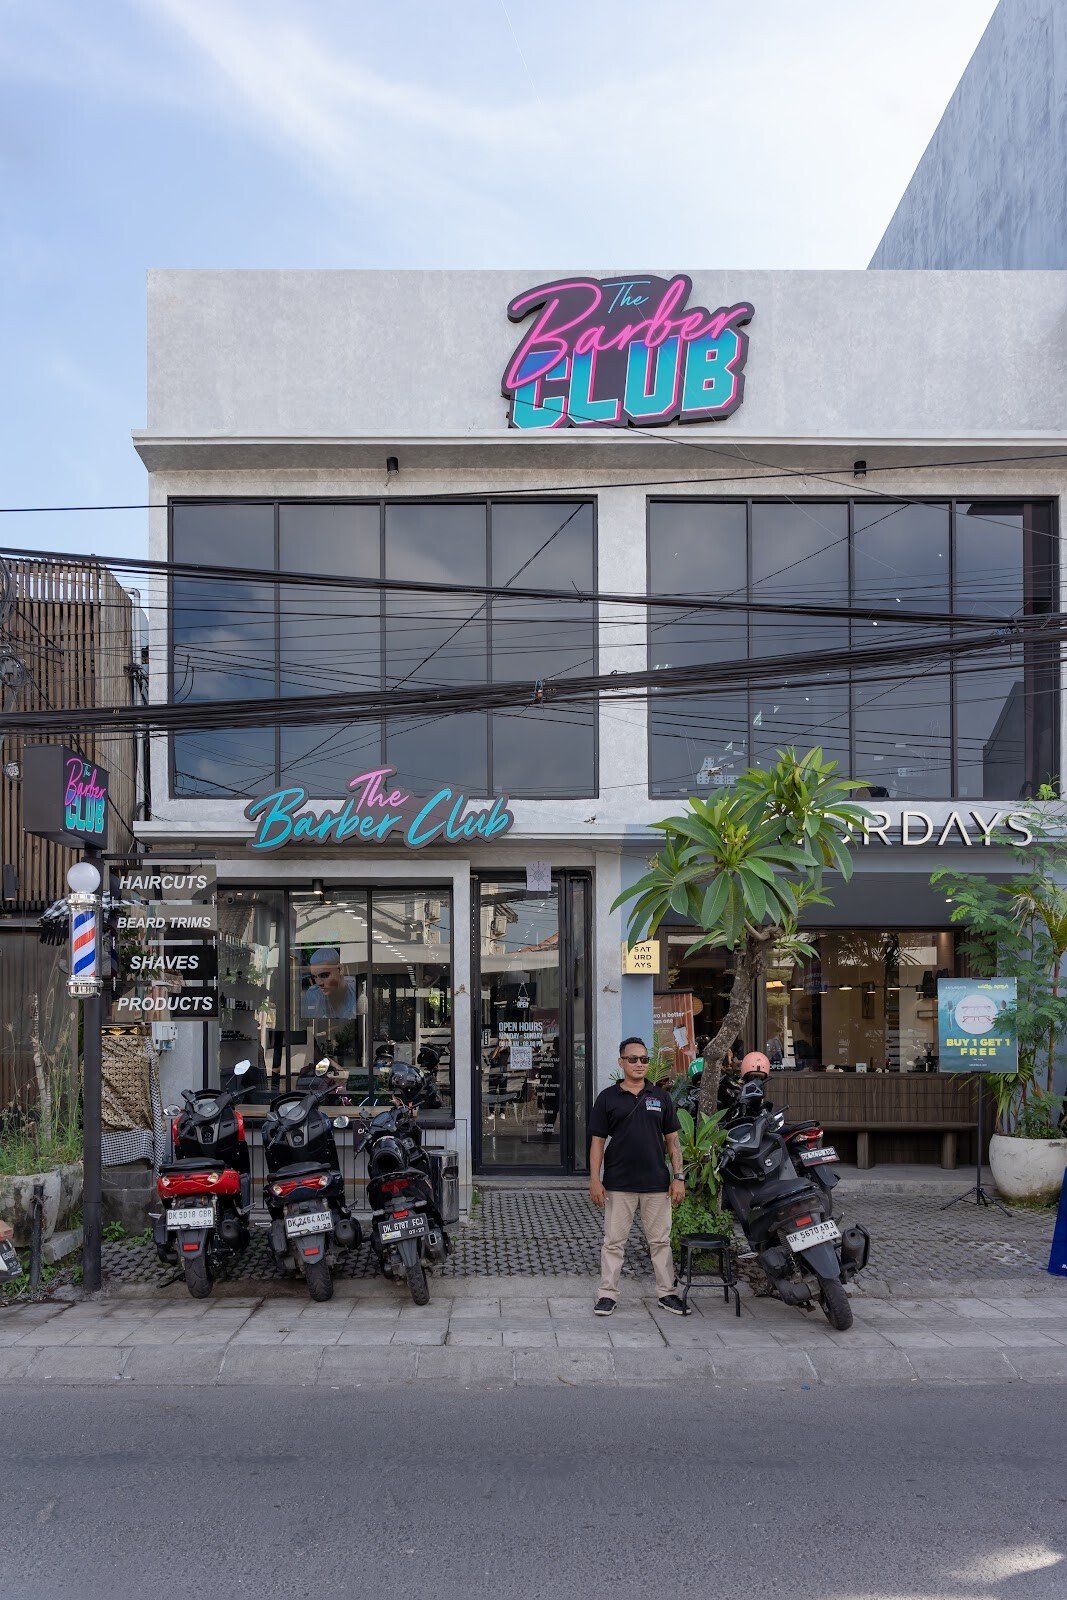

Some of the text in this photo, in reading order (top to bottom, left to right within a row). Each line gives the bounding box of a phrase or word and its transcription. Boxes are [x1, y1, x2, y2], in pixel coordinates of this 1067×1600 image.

[602, 280, 651, 314] The
[506, 279, 748, 389] Barber
[513, 328, 742, 429] CLUB
[65, 758, 107, 806] Barber
[350, 768, 409, 812] The
[66, 789, 105, 834] CLUB
[250, 787, 509, 849] Barber Club
[119, 875, 208, 890] HAIRCUTS
[117, 916, 212, 929] BEARD TRIMS
[130, 955, 200, 970] SHAVES
[117, 996, 214, 1011] PRODUCTS
[498, 1022, 518, 1032] OPEN
[519, 1022, 543, 1032] HOURS
[523, 1032, 543, 1040] SUNDAY
[946, 1038, 1010, 1047] BUY 1 GET 1
[960, 1047, 996, 1056] FREE
[169, 1211, 177, 1220] DK
[382, 1225, 392, 1233] DK
[788, 1221, 835, 1243] DK 5670 ABJ
